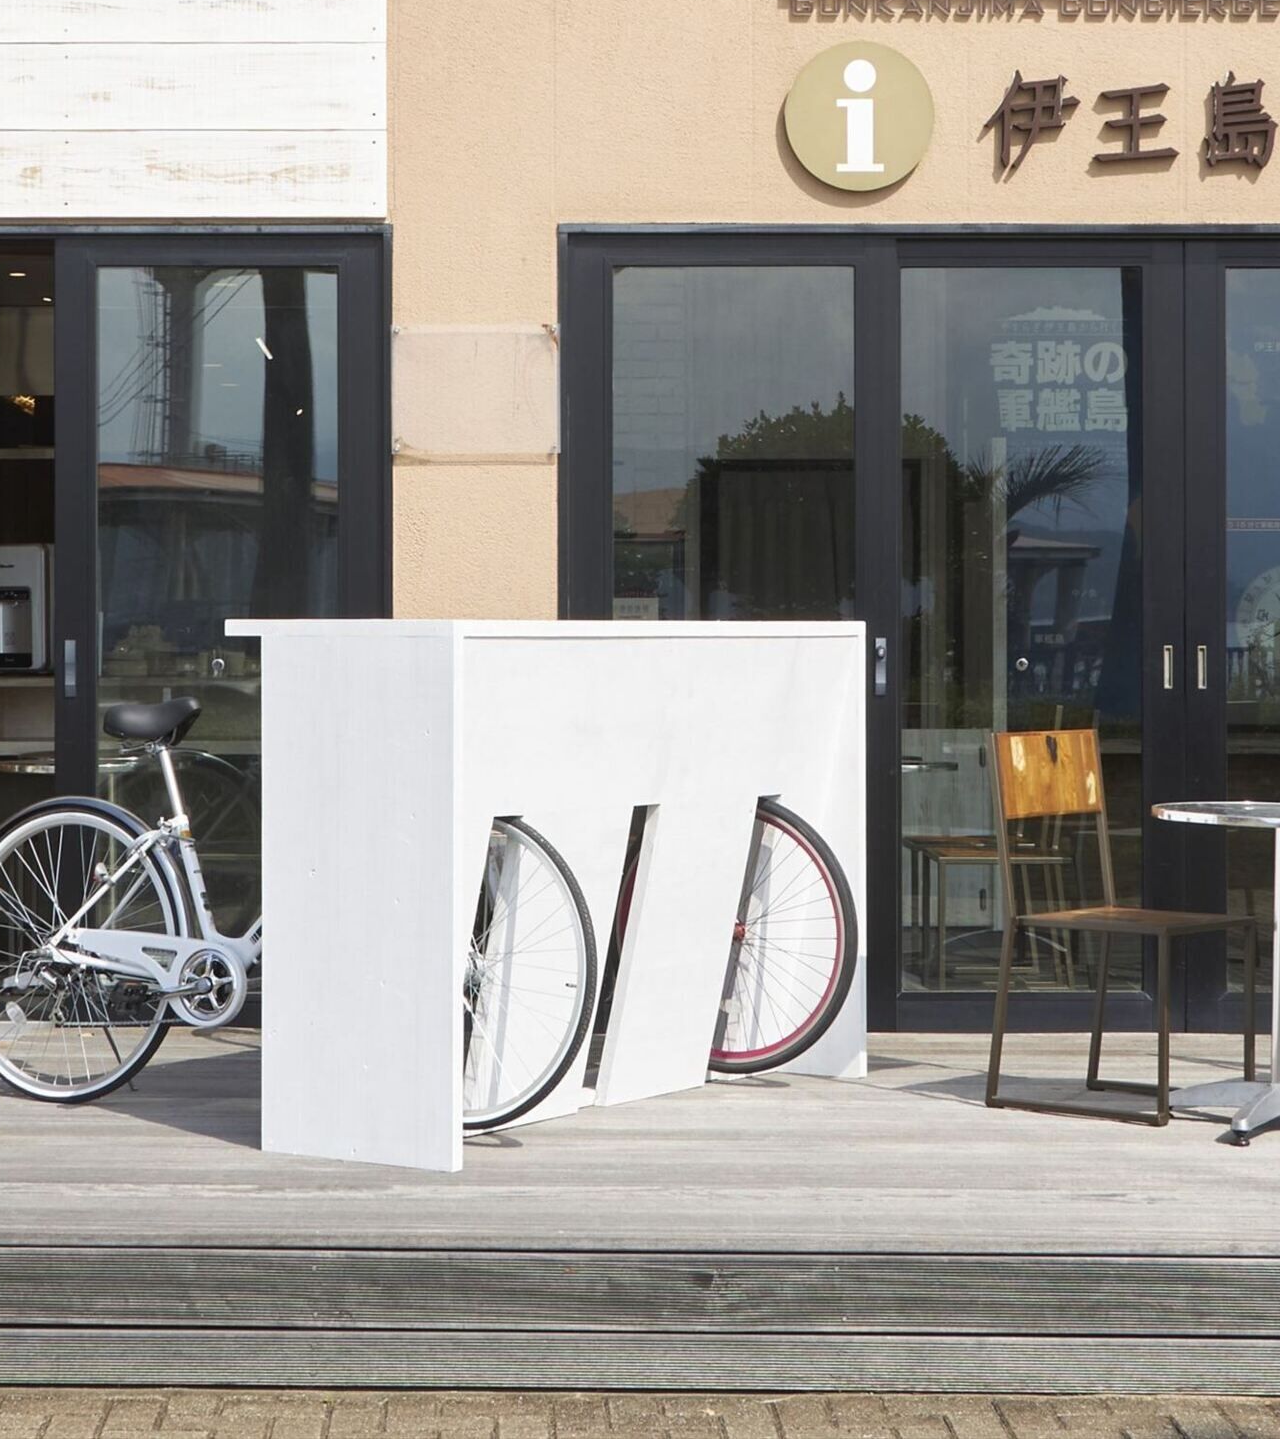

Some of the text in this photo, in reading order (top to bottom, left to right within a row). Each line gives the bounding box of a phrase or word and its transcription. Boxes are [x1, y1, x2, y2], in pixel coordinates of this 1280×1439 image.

[989, 340, 1128, 385] 奇跡の
[997, 388, 1128, 432] 軍艦島
